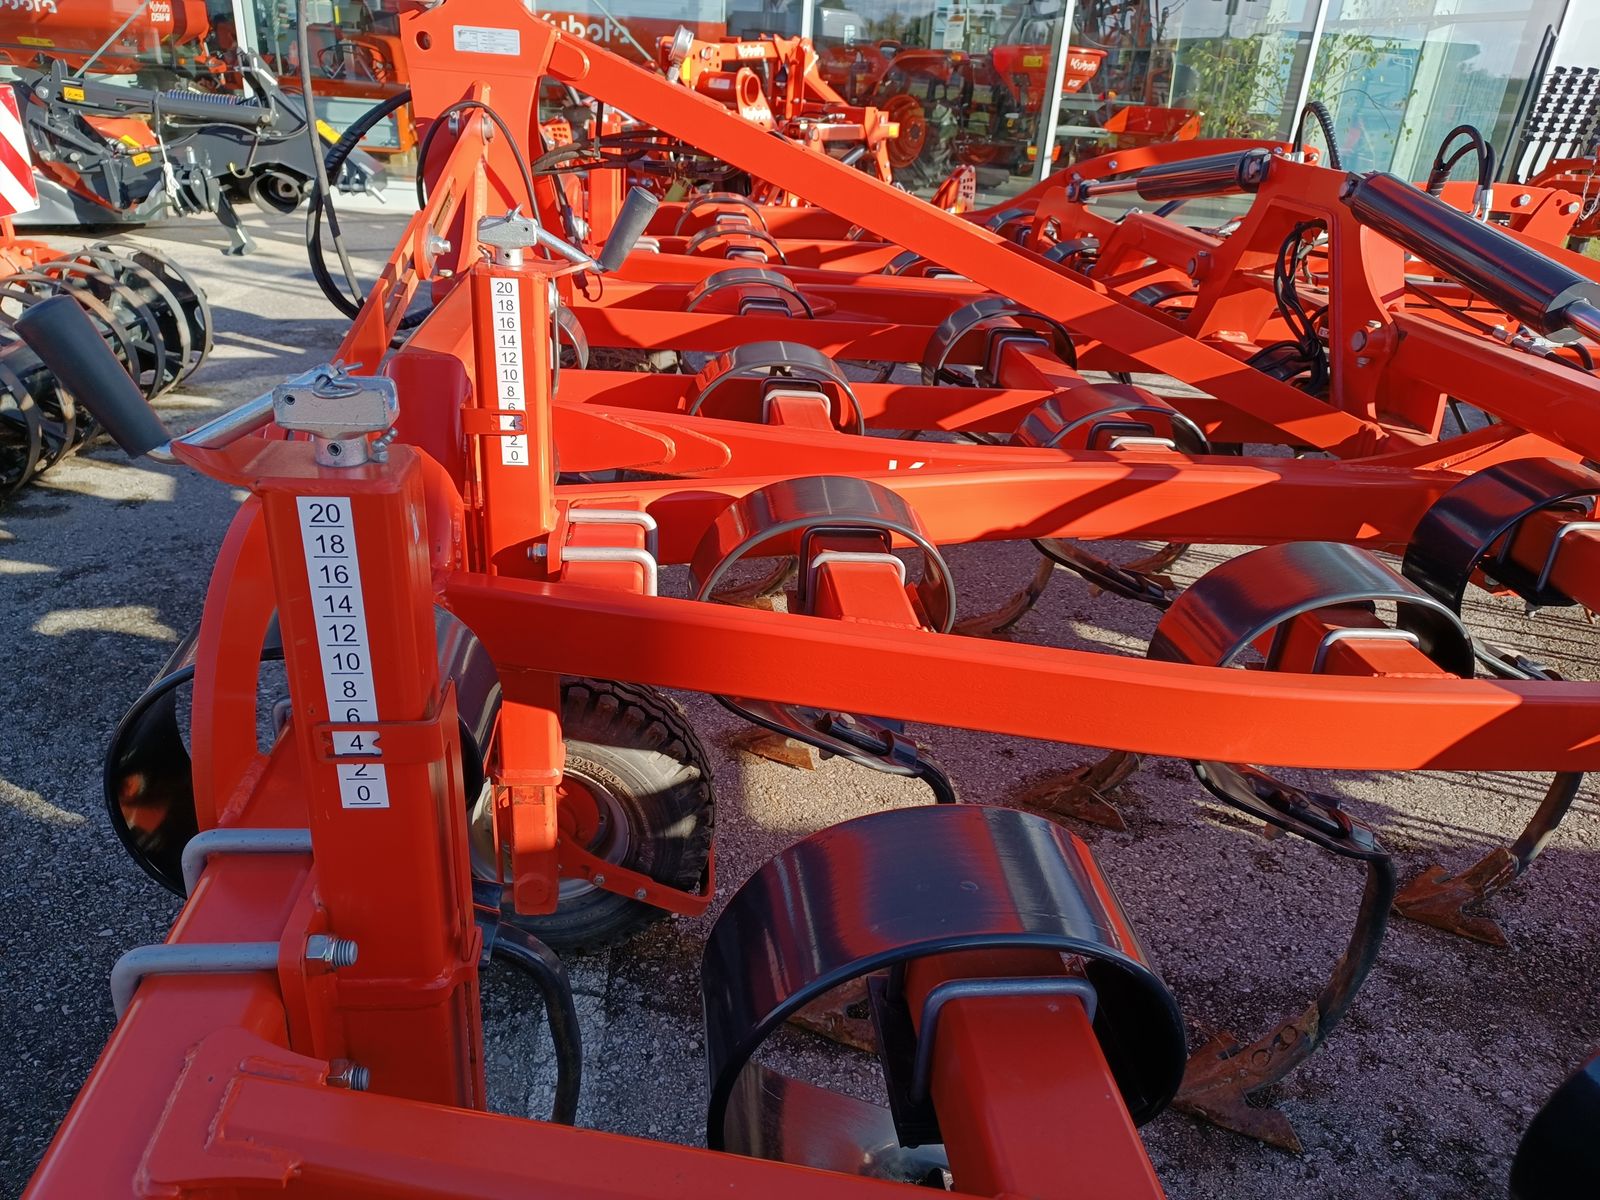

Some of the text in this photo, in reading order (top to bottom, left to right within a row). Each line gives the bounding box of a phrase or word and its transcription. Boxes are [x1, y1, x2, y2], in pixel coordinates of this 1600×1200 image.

[496, 281, 513, 294] 20
[498, 299, 514, 312] 18
[499, 317, 515, 330] 16
[500, 334, 516, 347] 14
[501, 352, 517, 364] 12
[502, 369, 518, 381] 10
[507, 385, 515, 397] 8
[508, 418, 517, 429] 4
[510, 435, 518, 446] 2
[510, 450, 519, 461] 0
[308, 503, 341, 524] 20
[315, 534, 345, 554] 18
[319, 564, 349, 584] 16
[323, 594, 353, 614] 14
[328, 623, 358, 643] 12
[332, 652, 361, 671] 10
[342, 680, 357, 699] 8
[346, 708, 361, 723] 6
[349, 734, 364, 751] 4
[354, 763, 368, 777] 2
[356, 785, 371, 802] 0
